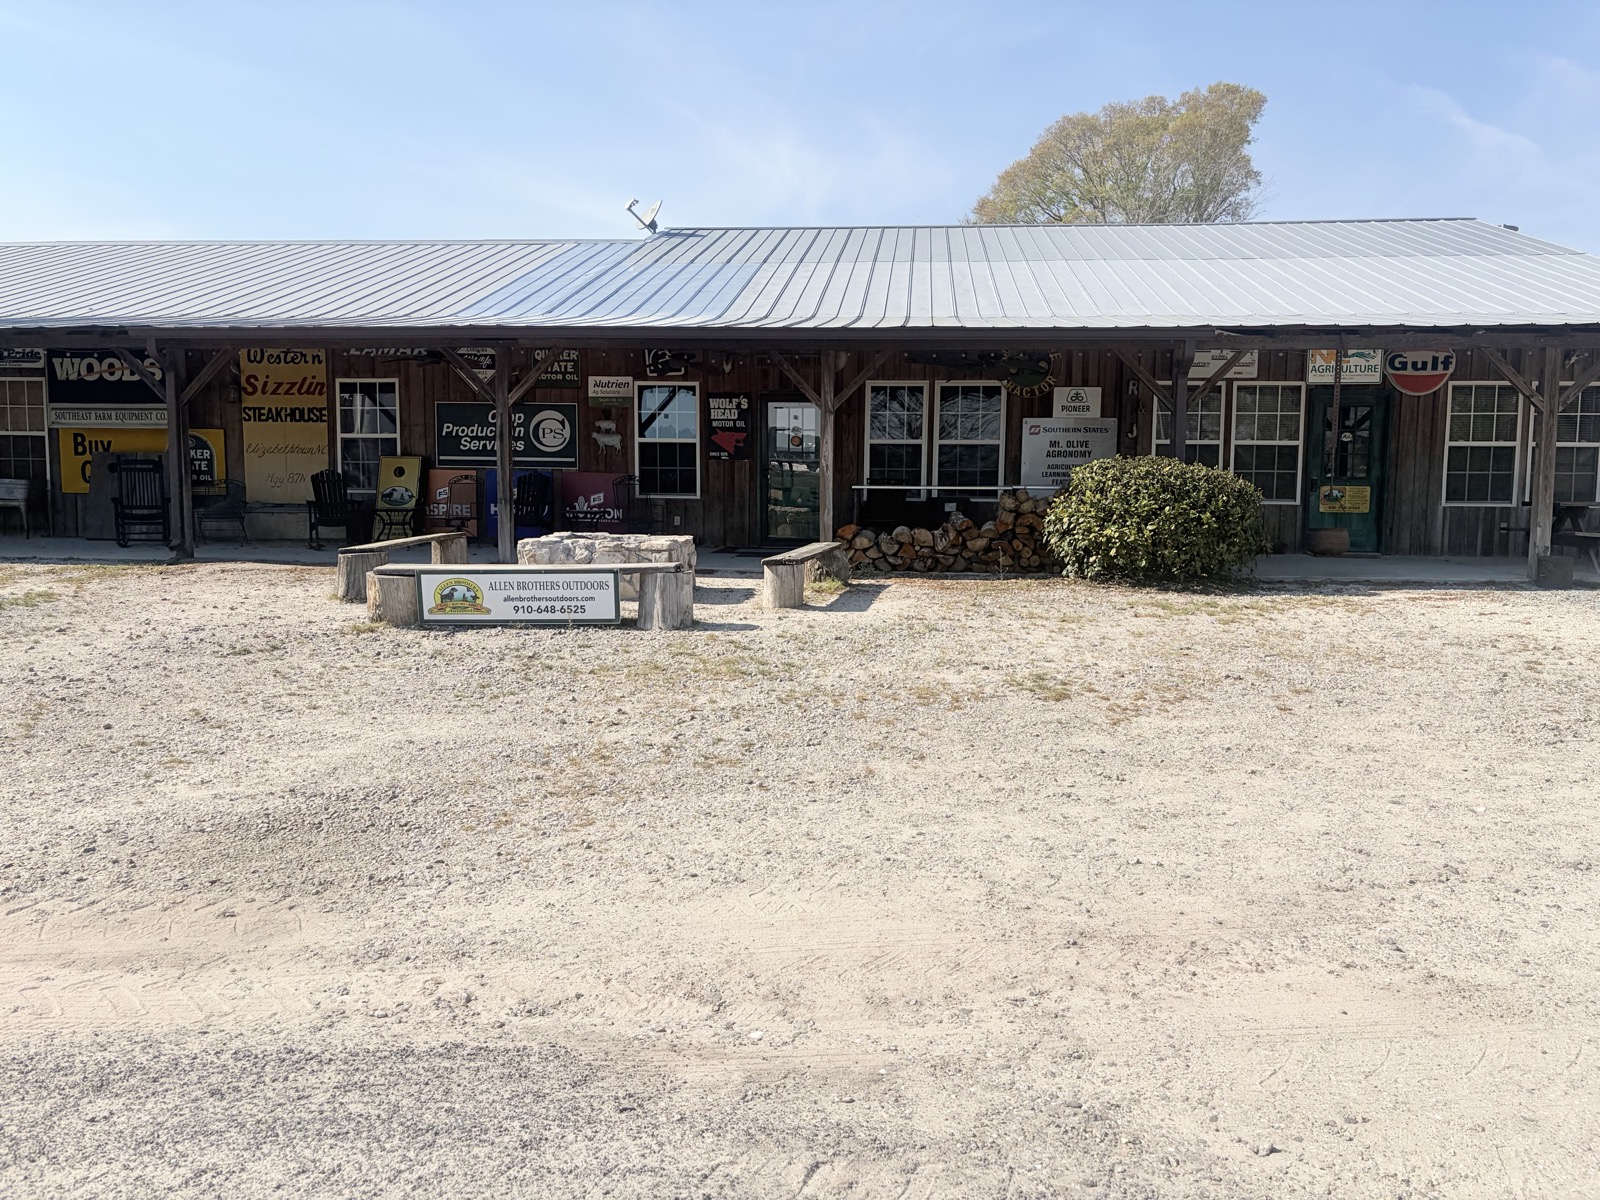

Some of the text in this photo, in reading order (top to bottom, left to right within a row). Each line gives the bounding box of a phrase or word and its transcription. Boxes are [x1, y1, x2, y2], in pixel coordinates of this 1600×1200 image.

[1388, 353, 1454, 372] Gulf
[1310, 364, 1380, 374] AGRIULTURE
[242, 374, 326, 396] Sizzlin
[593, 379, 630, 389] Nutrien
[1127, 380, 1139, 395] R
[709, 395, 749, 409] WOLF'S
[54, 412, 167, 422] SOUTHEAST FARM EQUIPMENT CO.
[242, 406, 327, 423] STEAKHOUSE
[710, 409, 739, 419] HEAD
[712, 420, 734, 428] MOTOR
[1049, 440, 1090, 448] Mt. OLIVE
[1045, 450, 1093, 458] AGRONOMY
[488, 581, 610, 591] ALLEN BROTHERS OUTDOORS
[503, 594, 596, 603] allenbrothersoutdoors.com
[513, 605, 587, 614] 910-648-6525
